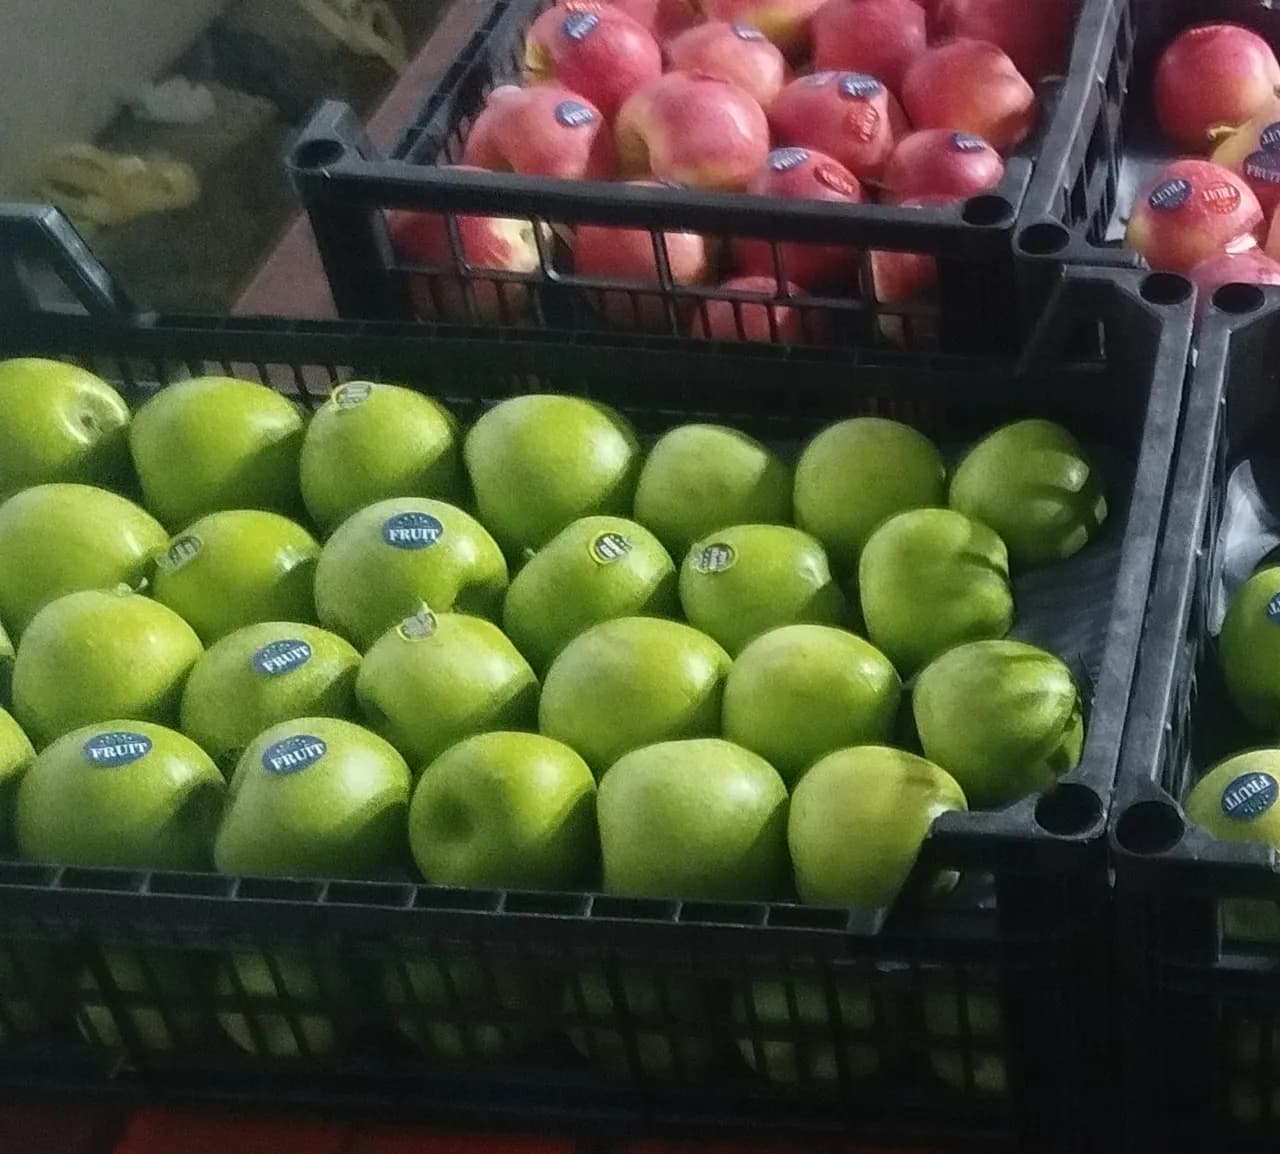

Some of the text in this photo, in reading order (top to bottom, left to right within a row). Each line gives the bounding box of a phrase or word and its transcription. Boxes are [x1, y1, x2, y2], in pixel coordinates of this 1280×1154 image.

[1150, 180, 1186, 206] FRUIT
[1203, 185, 1236, 202] FRUIT
[388, 527, 441, 542] FRUIT
[262, 644, 311, 674] FRUIT
[89, 742, 148, 759] FRUIT
[271, 742, 325, 770] FRUIT
[1226, 775, 1269, 811] FRUIT
